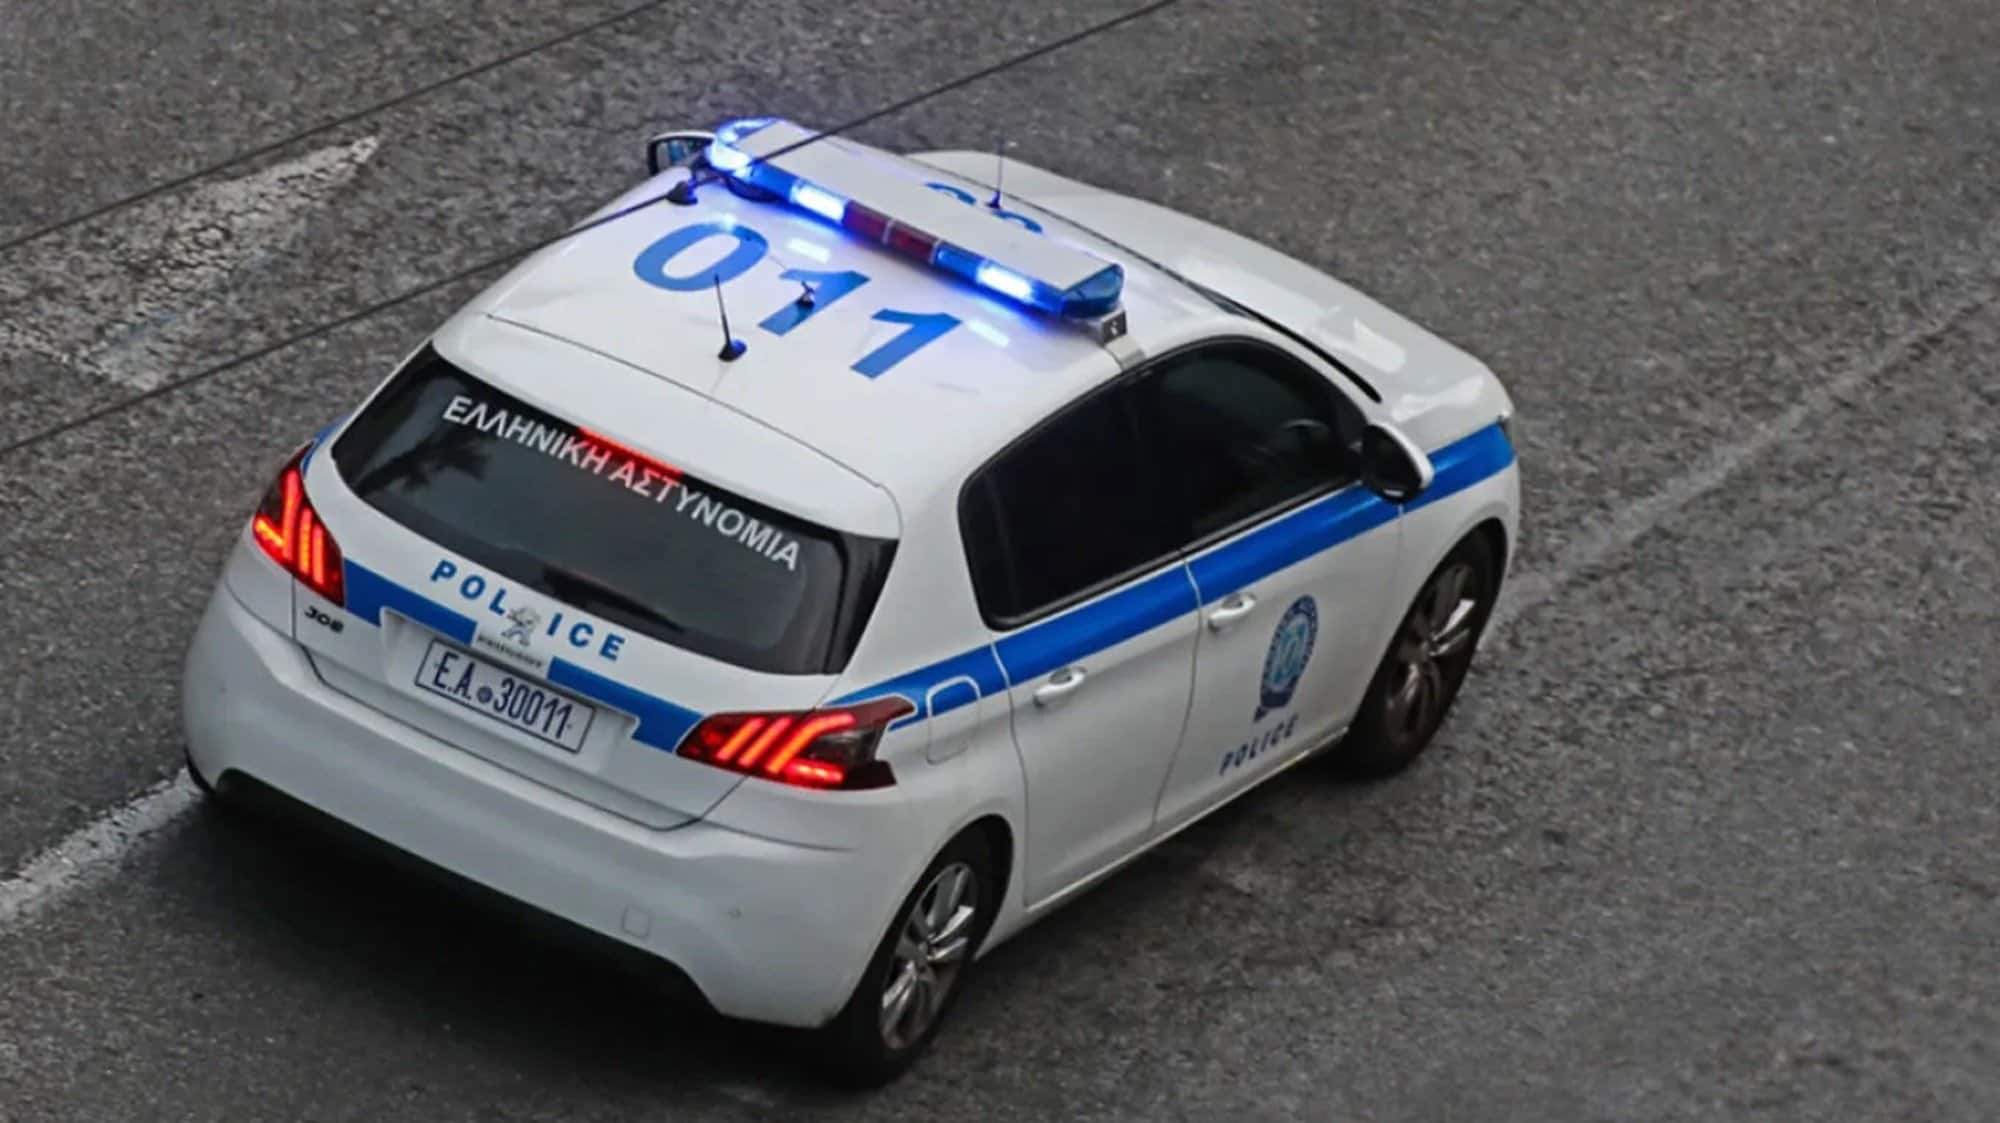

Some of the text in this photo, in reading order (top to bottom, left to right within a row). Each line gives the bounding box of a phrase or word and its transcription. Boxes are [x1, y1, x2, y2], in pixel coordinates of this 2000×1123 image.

[633, 221, 962, 380] 011
[441, 394, 802, 571] ΕΛΛΗΝΙΚΗ ΑΣΤΥΝΟΜΙΑ
[430, 560, 626, 662] POLICE
[1219, 712, 1299, 776] POLICE
